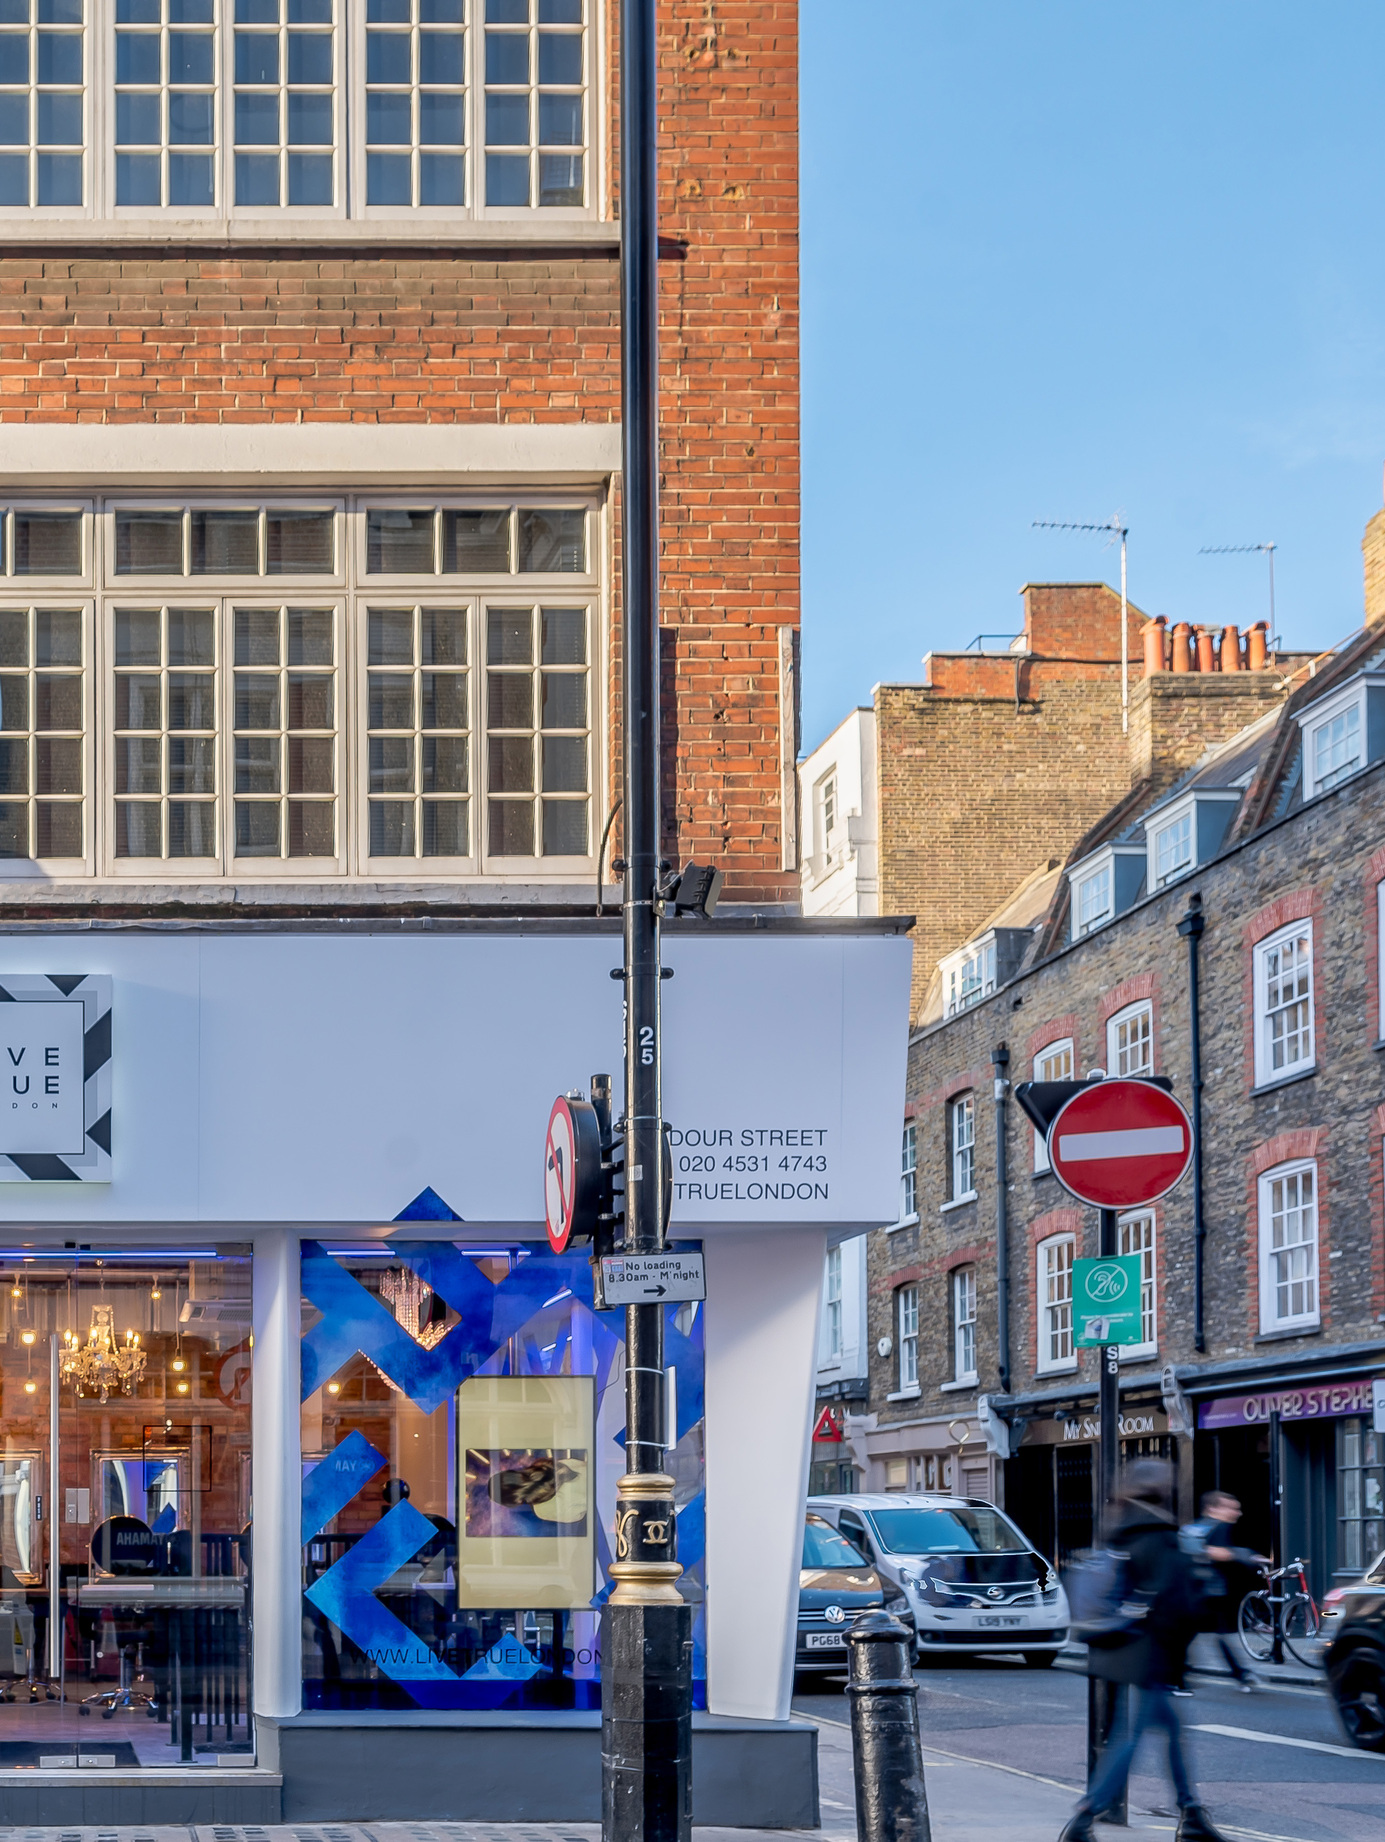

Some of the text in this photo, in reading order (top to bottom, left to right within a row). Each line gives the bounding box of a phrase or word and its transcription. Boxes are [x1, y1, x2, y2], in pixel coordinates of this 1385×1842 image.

[740, 1129, 828, 1146] STREET
[679, 1155, 827, 1172] 020 4531 4743
[625, 1262, 640, 1270] No
[644, 1260, 681, 1270] loading
[608, 1273, 649, 1283] 8.30am
[660, 1270, 700, 1280] M'night
